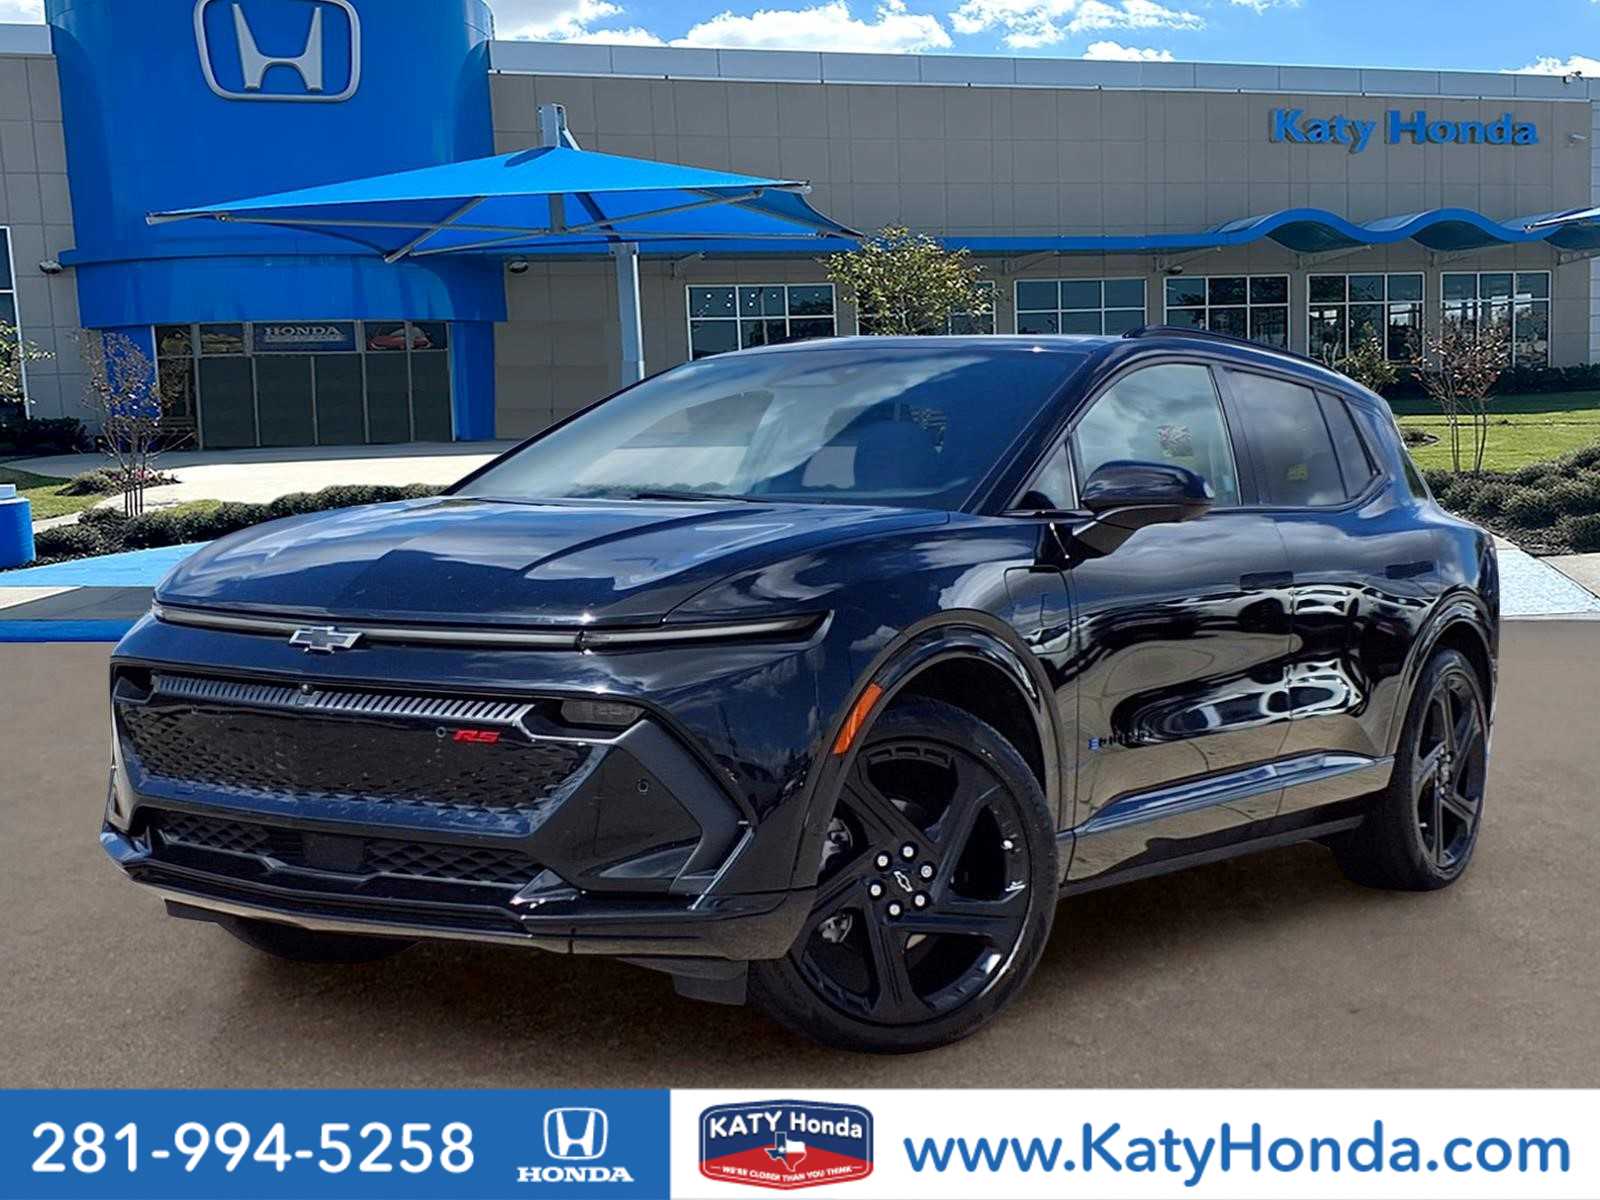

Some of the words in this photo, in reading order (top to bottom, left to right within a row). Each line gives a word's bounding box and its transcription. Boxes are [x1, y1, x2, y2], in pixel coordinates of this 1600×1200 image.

[1270, 108, 1377, 153] Katy
[1385, 110, 1540, 145] Honda
[264, 326, 344, 336] HONDA
[453, 730, 500, 742] RS
